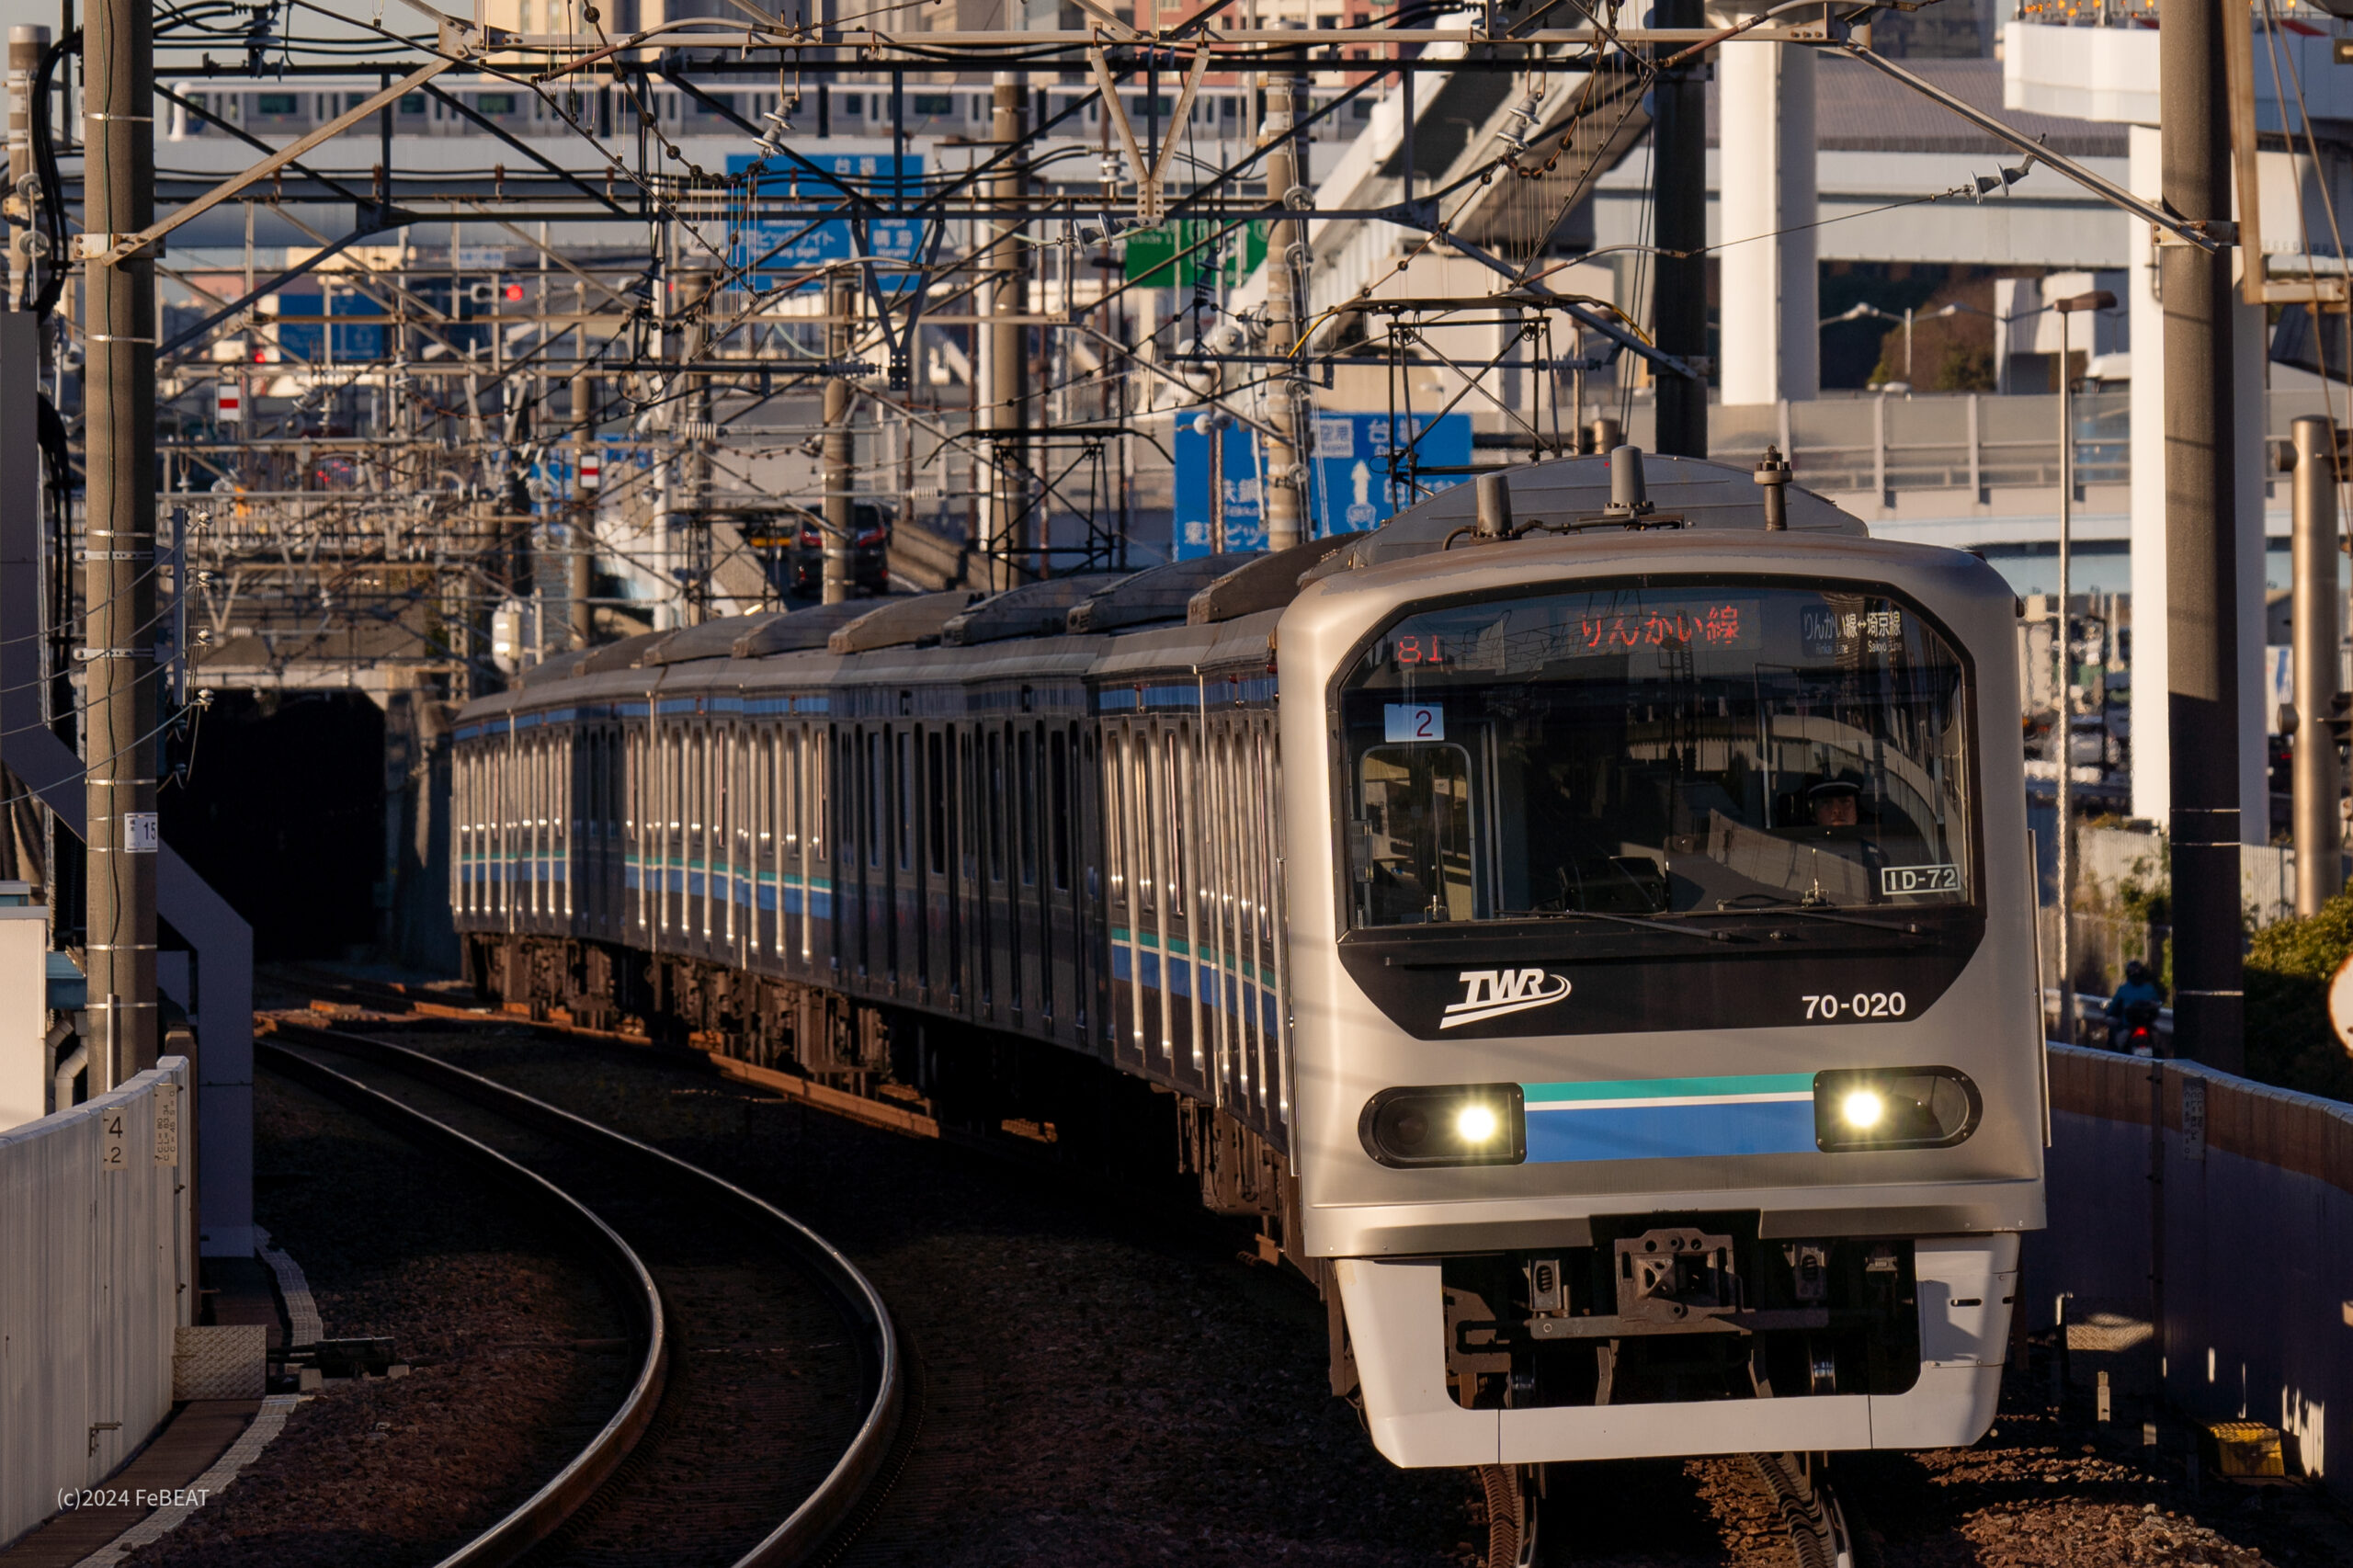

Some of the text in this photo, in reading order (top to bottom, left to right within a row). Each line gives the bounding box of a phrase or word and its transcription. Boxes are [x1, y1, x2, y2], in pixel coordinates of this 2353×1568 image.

[1582, 604, 1740, 646] りんかい線
[1398, 635, 1443, 663] 81
[1415, 710, 1434, 737] 2
[1458, 968, 1546, 1006] TWR
[1802, 992, 1906, 1019] 70-020
[108, 1116, 123, 1139] 4
[110, 1146, 121, 1164] 2
